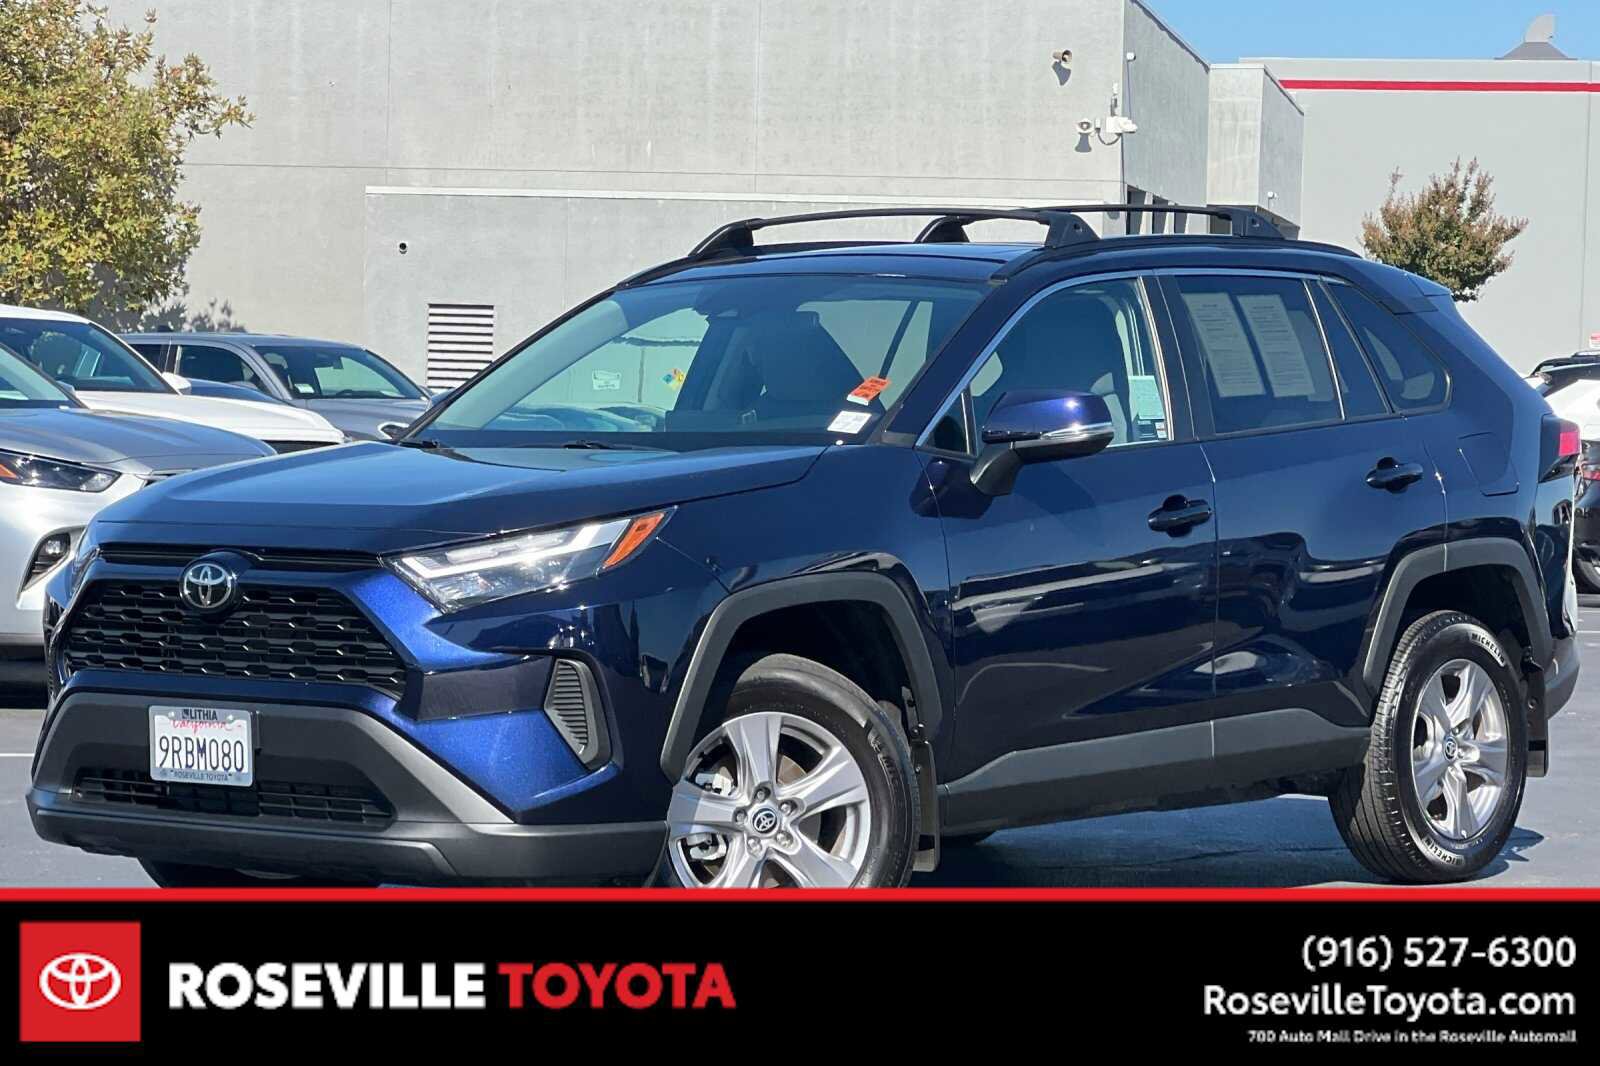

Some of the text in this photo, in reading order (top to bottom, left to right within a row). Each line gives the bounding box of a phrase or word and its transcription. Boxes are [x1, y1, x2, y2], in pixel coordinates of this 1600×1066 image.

[1471, 632, 1505, 664] MICHELIN
[189, 708, 218, 721] LITHIA
[159, 735, 244, 772] 9RBM080
[206, 772, 228, 781] TOYOTA
[1424, 836, 1463, 865] MICHELIN
